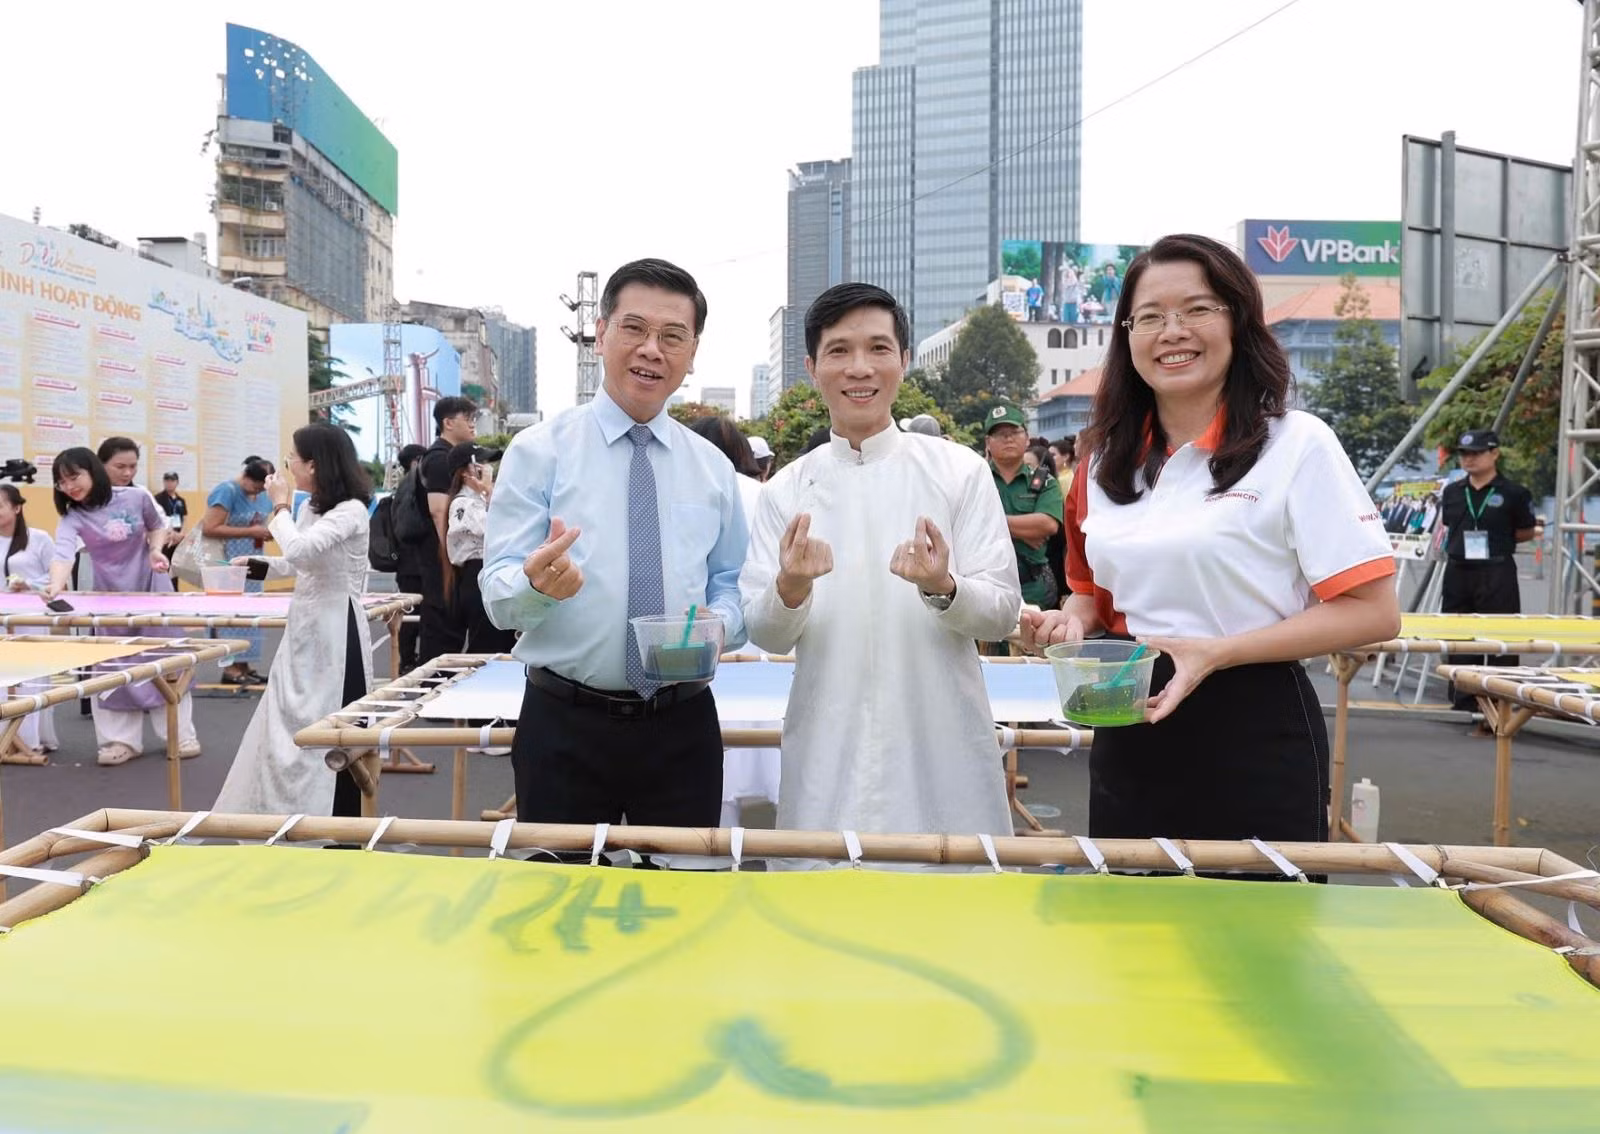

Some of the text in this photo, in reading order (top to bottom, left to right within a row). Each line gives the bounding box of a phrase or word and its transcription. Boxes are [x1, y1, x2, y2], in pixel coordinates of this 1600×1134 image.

[1302, 238, 1400, 263] VPBank
[40, 281, 90, 310] HOẠT
[93, 294, 142, 321] ĐỘNG
[1243, 493, 1259, 503] CITY
